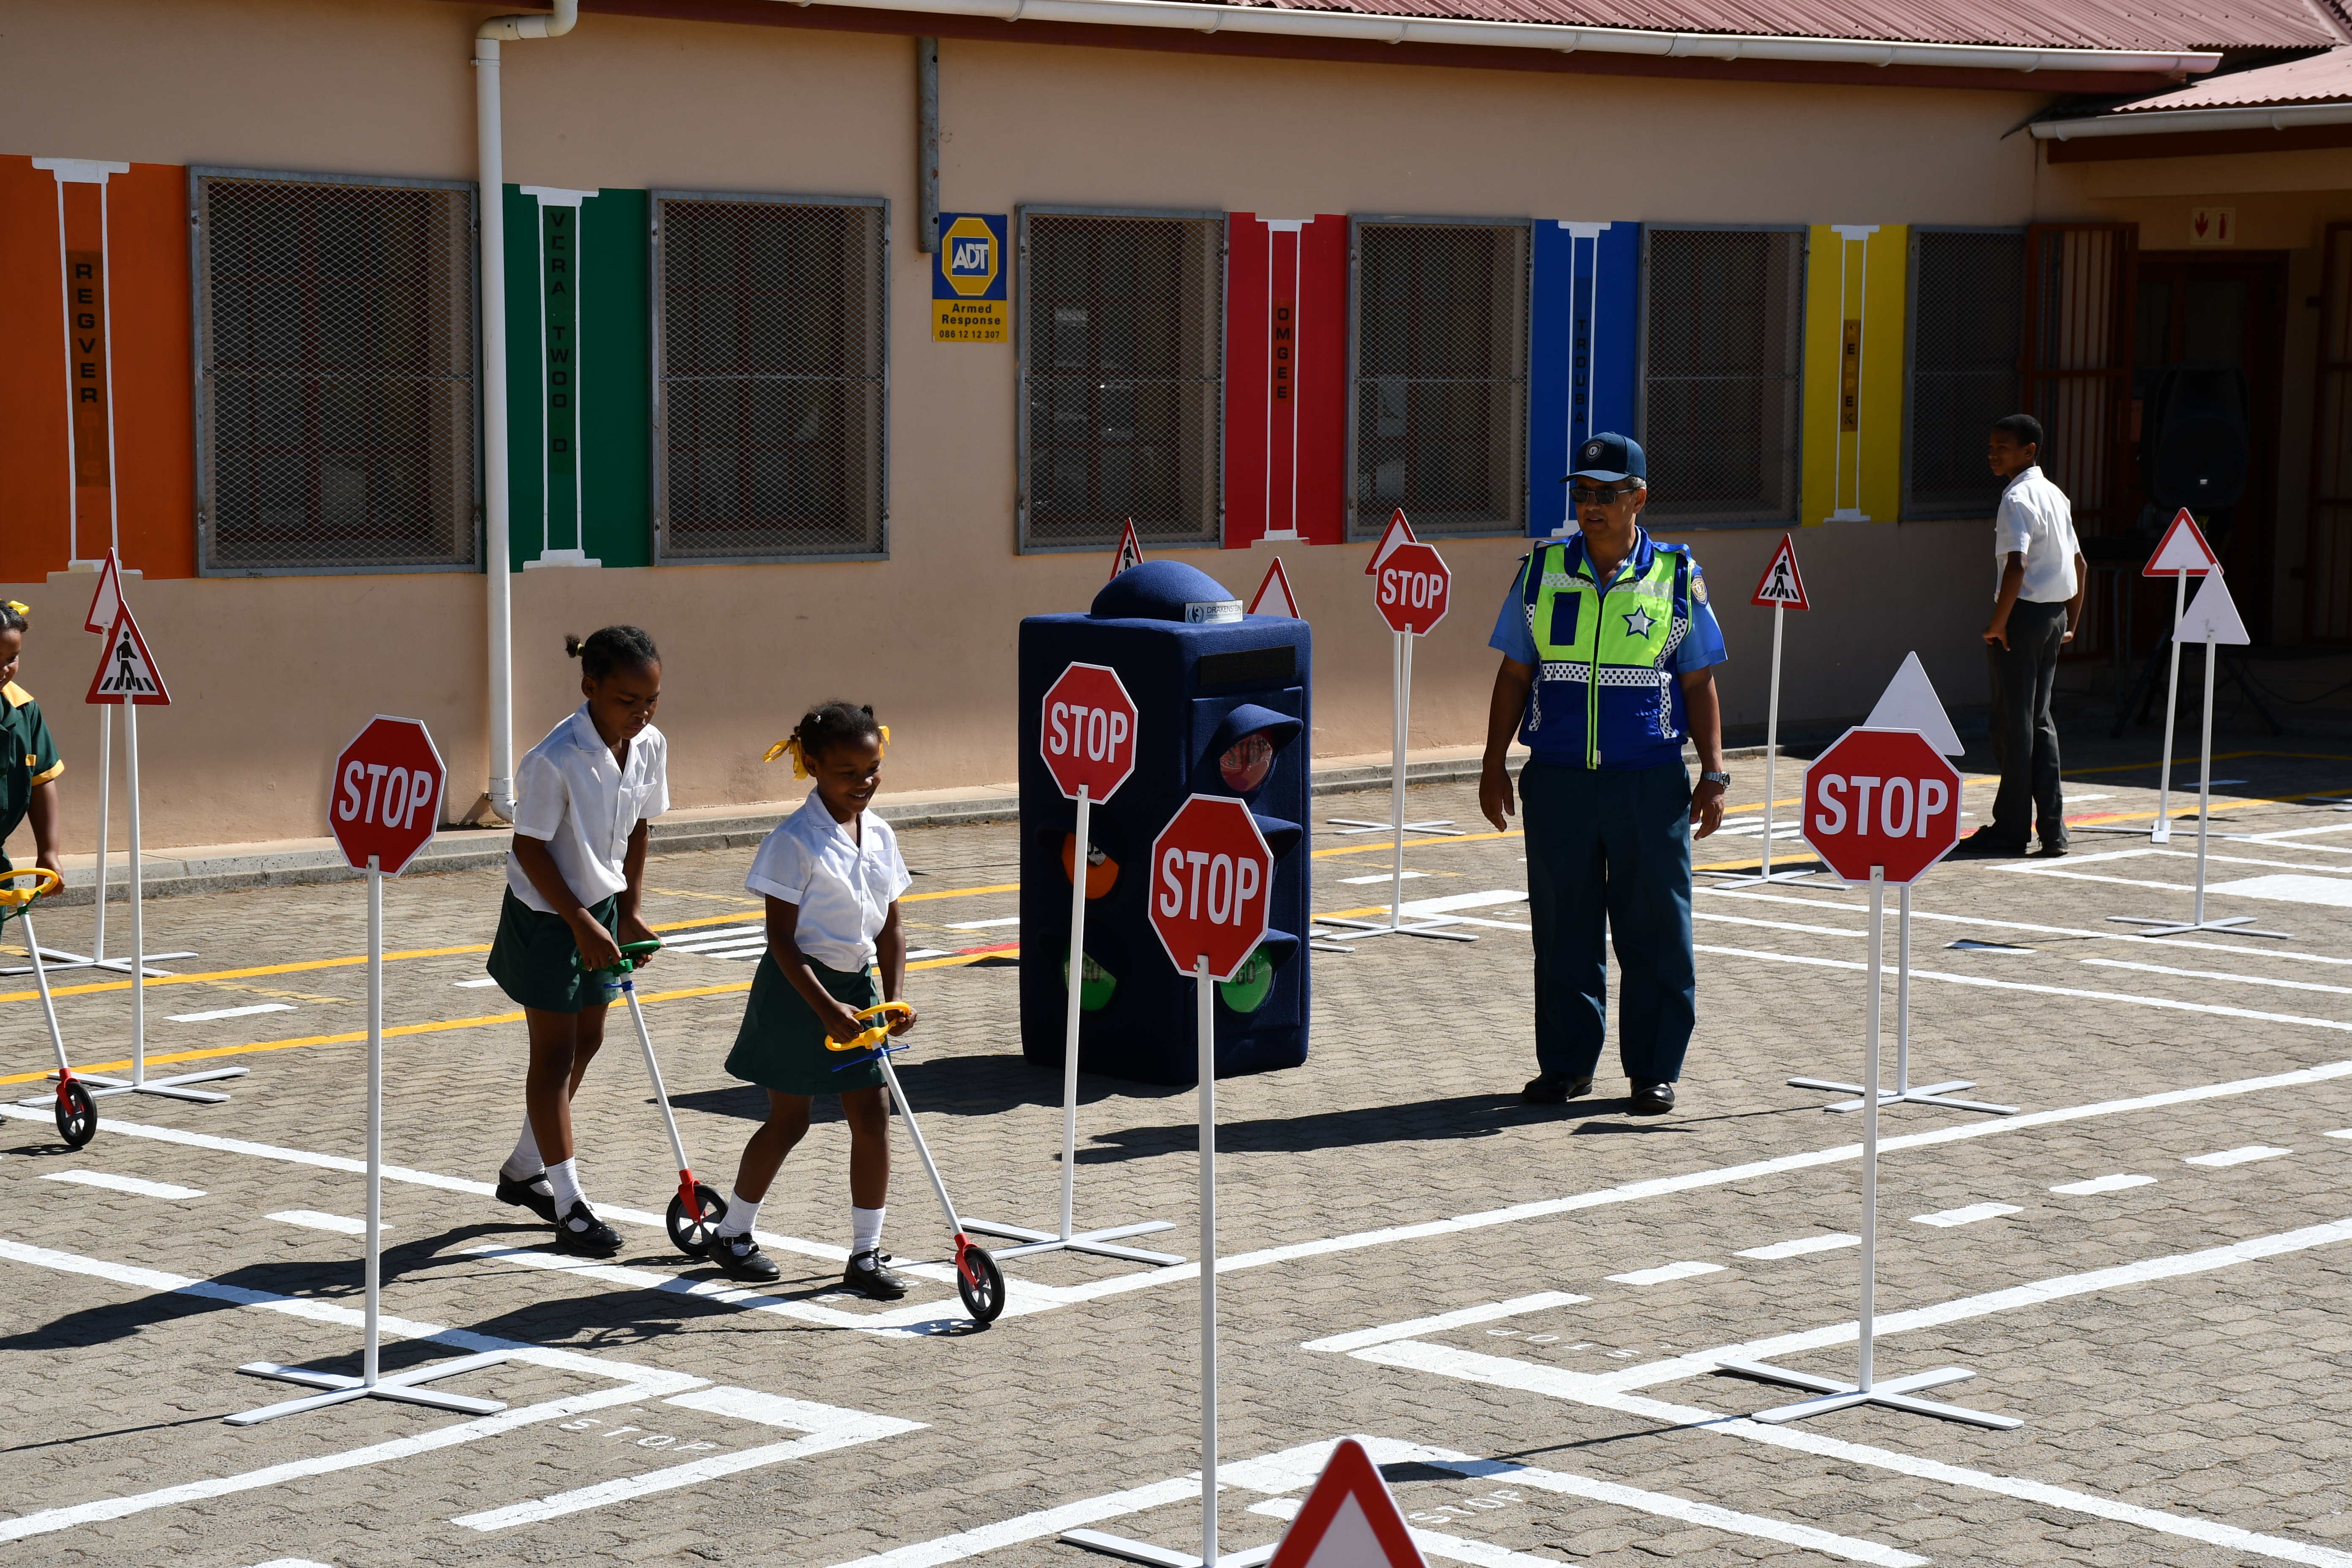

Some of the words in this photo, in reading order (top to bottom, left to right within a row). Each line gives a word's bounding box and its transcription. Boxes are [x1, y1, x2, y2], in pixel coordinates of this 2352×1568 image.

[952, 243, 989, 270] ADT
[942, 314, 1001, 326] Response
[952, 303, 991, 313] Armed
[939, 330, 955, 338] 086
[1276, 308, 1290, 399] OMGEE
[1381, 568, 1443, 609] STOP
[1207, 604, 1241, 613] DRAKENSTEIN
[1049, 701, 1129, 763] STOP
[1228, 738, 1266, 765] STOP
[338, 760, 433, 830] STOP
[1815, 773, 1949, 838] STOP
[1159, 847, 1260, 927] STOP
[1081, 957, 1101, 983] GO
[1236, 961, 1256, 985] GO
[558, 1418, 716, 1450] STOP
[1408, 1490, 1524, 1524] STOP
